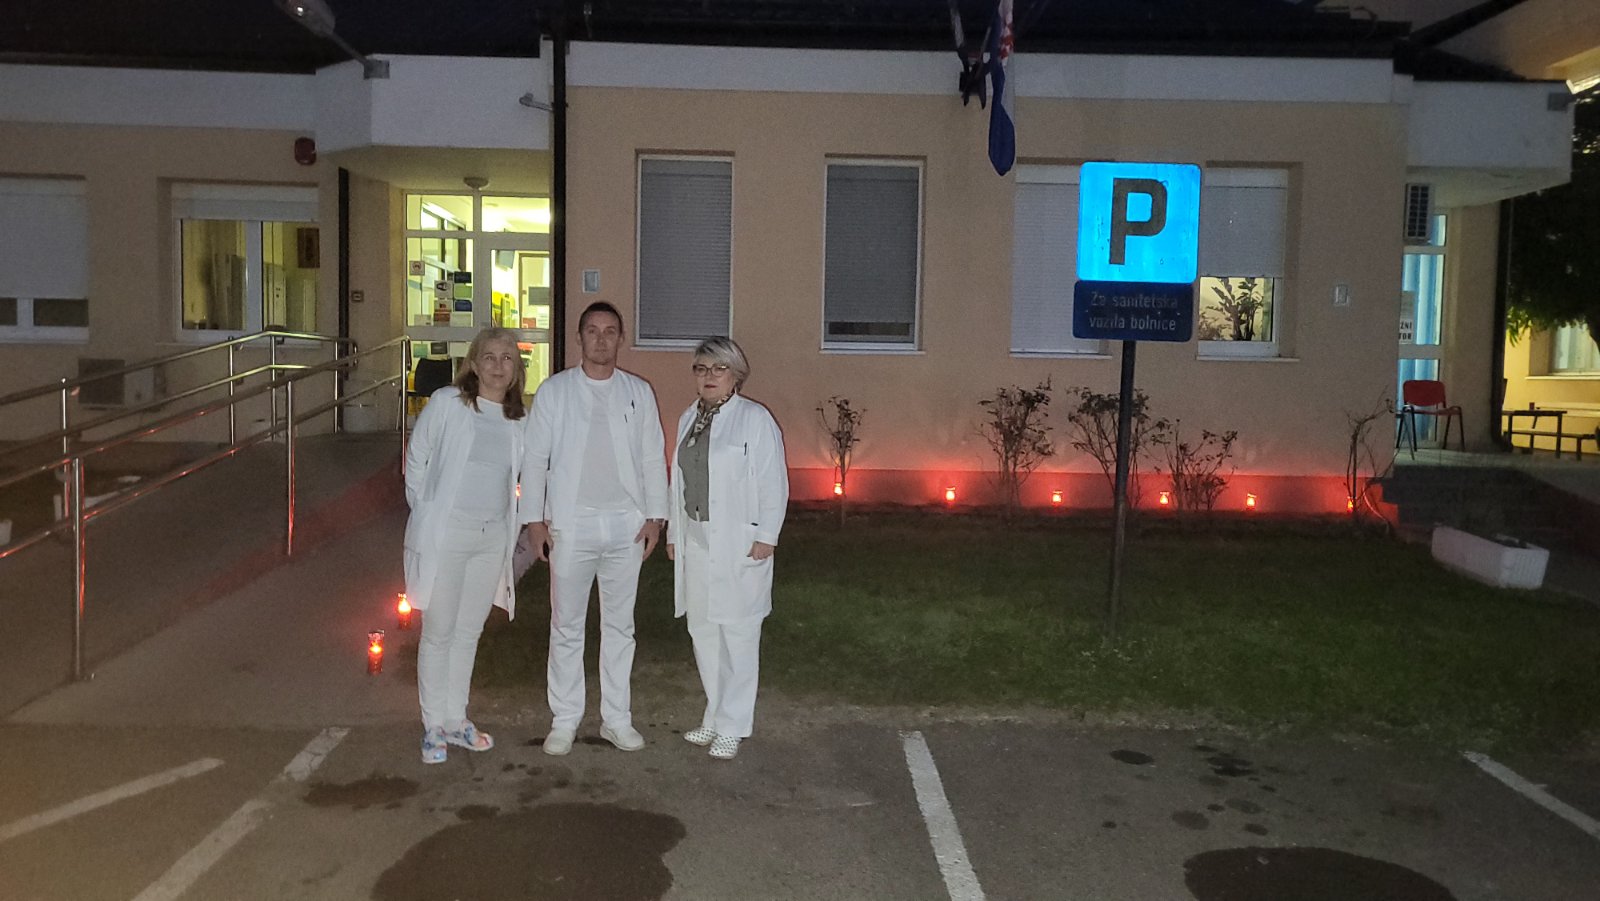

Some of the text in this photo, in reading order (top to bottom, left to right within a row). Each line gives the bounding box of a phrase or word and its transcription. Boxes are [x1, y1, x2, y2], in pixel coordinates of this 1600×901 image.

[1109, 178, 1167, 265] P
[1091, 291, 1178, 309] Za sanitetska
[1090, 314, 1176, 331] vozila bolnice
